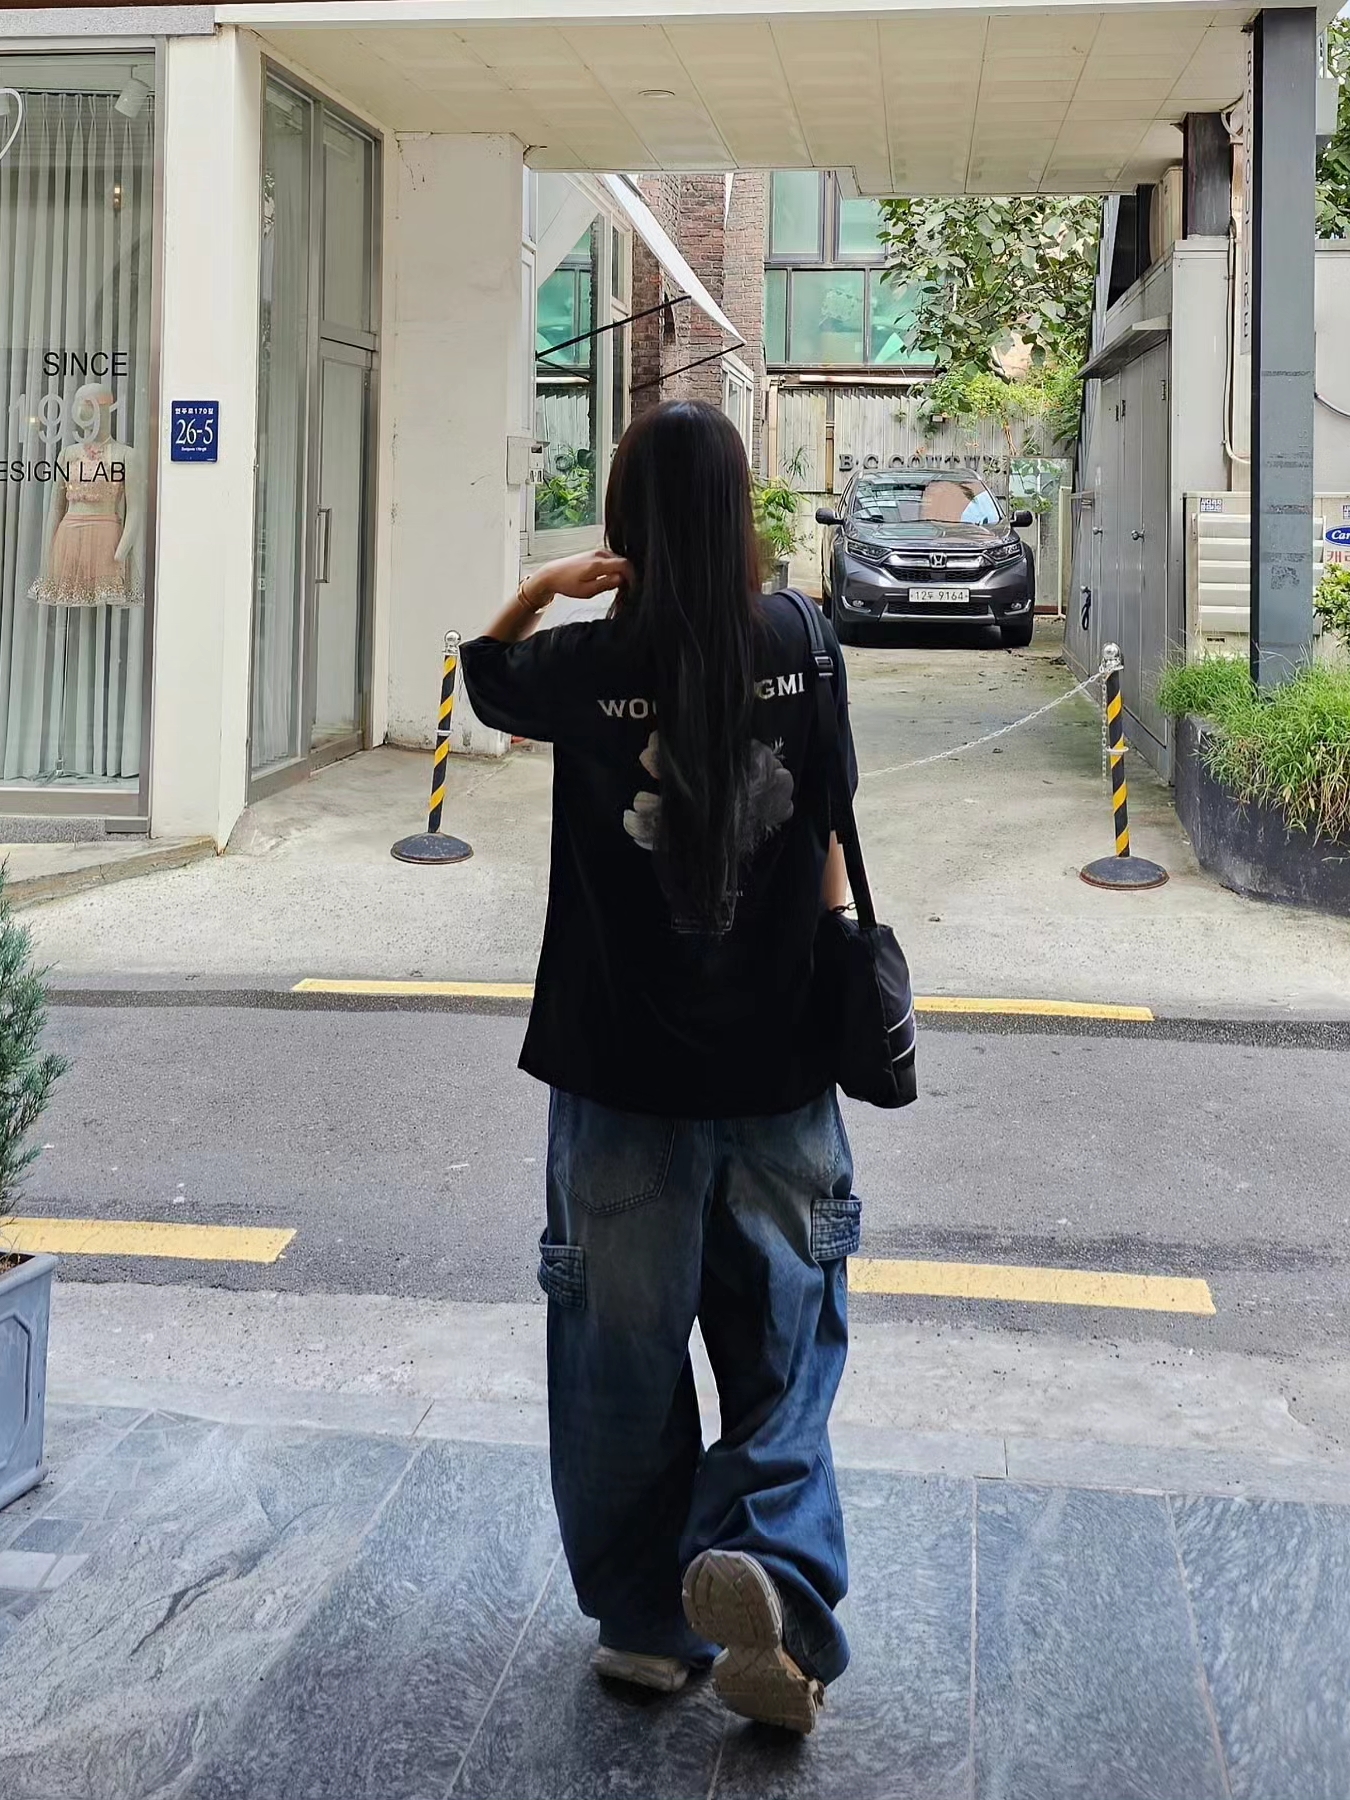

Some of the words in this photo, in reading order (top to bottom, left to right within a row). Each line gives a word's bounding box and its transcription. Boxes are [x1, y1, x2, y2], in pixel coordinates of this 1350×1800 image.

[43, 352, 128, 376] SINCE
[9, 393, 127, 444] 1991
[175, 418, 214, 445] 26-5
[80, 461, 126, 482] LAB
[938, 591, 964, 601] 9164
